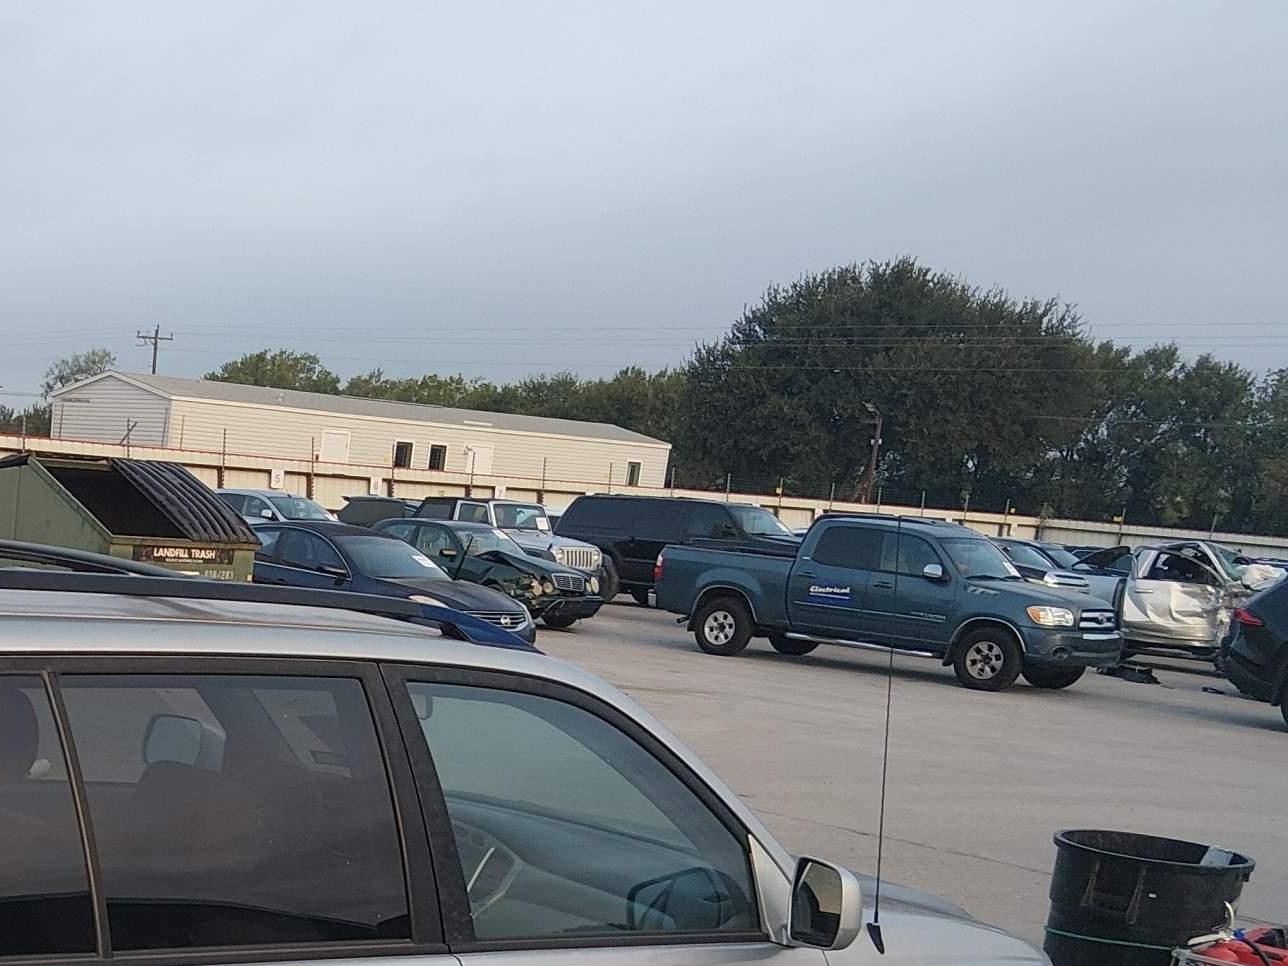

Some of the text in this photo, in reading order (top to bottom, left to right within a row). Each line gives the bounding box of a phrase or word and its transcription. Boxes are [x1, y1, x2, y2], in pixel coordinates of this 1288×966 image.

[274, 473, 281, 484] 5
[153, 547, 216, 559] LANDFILL TRASH
[809, 585, 851, 593] Electrical
